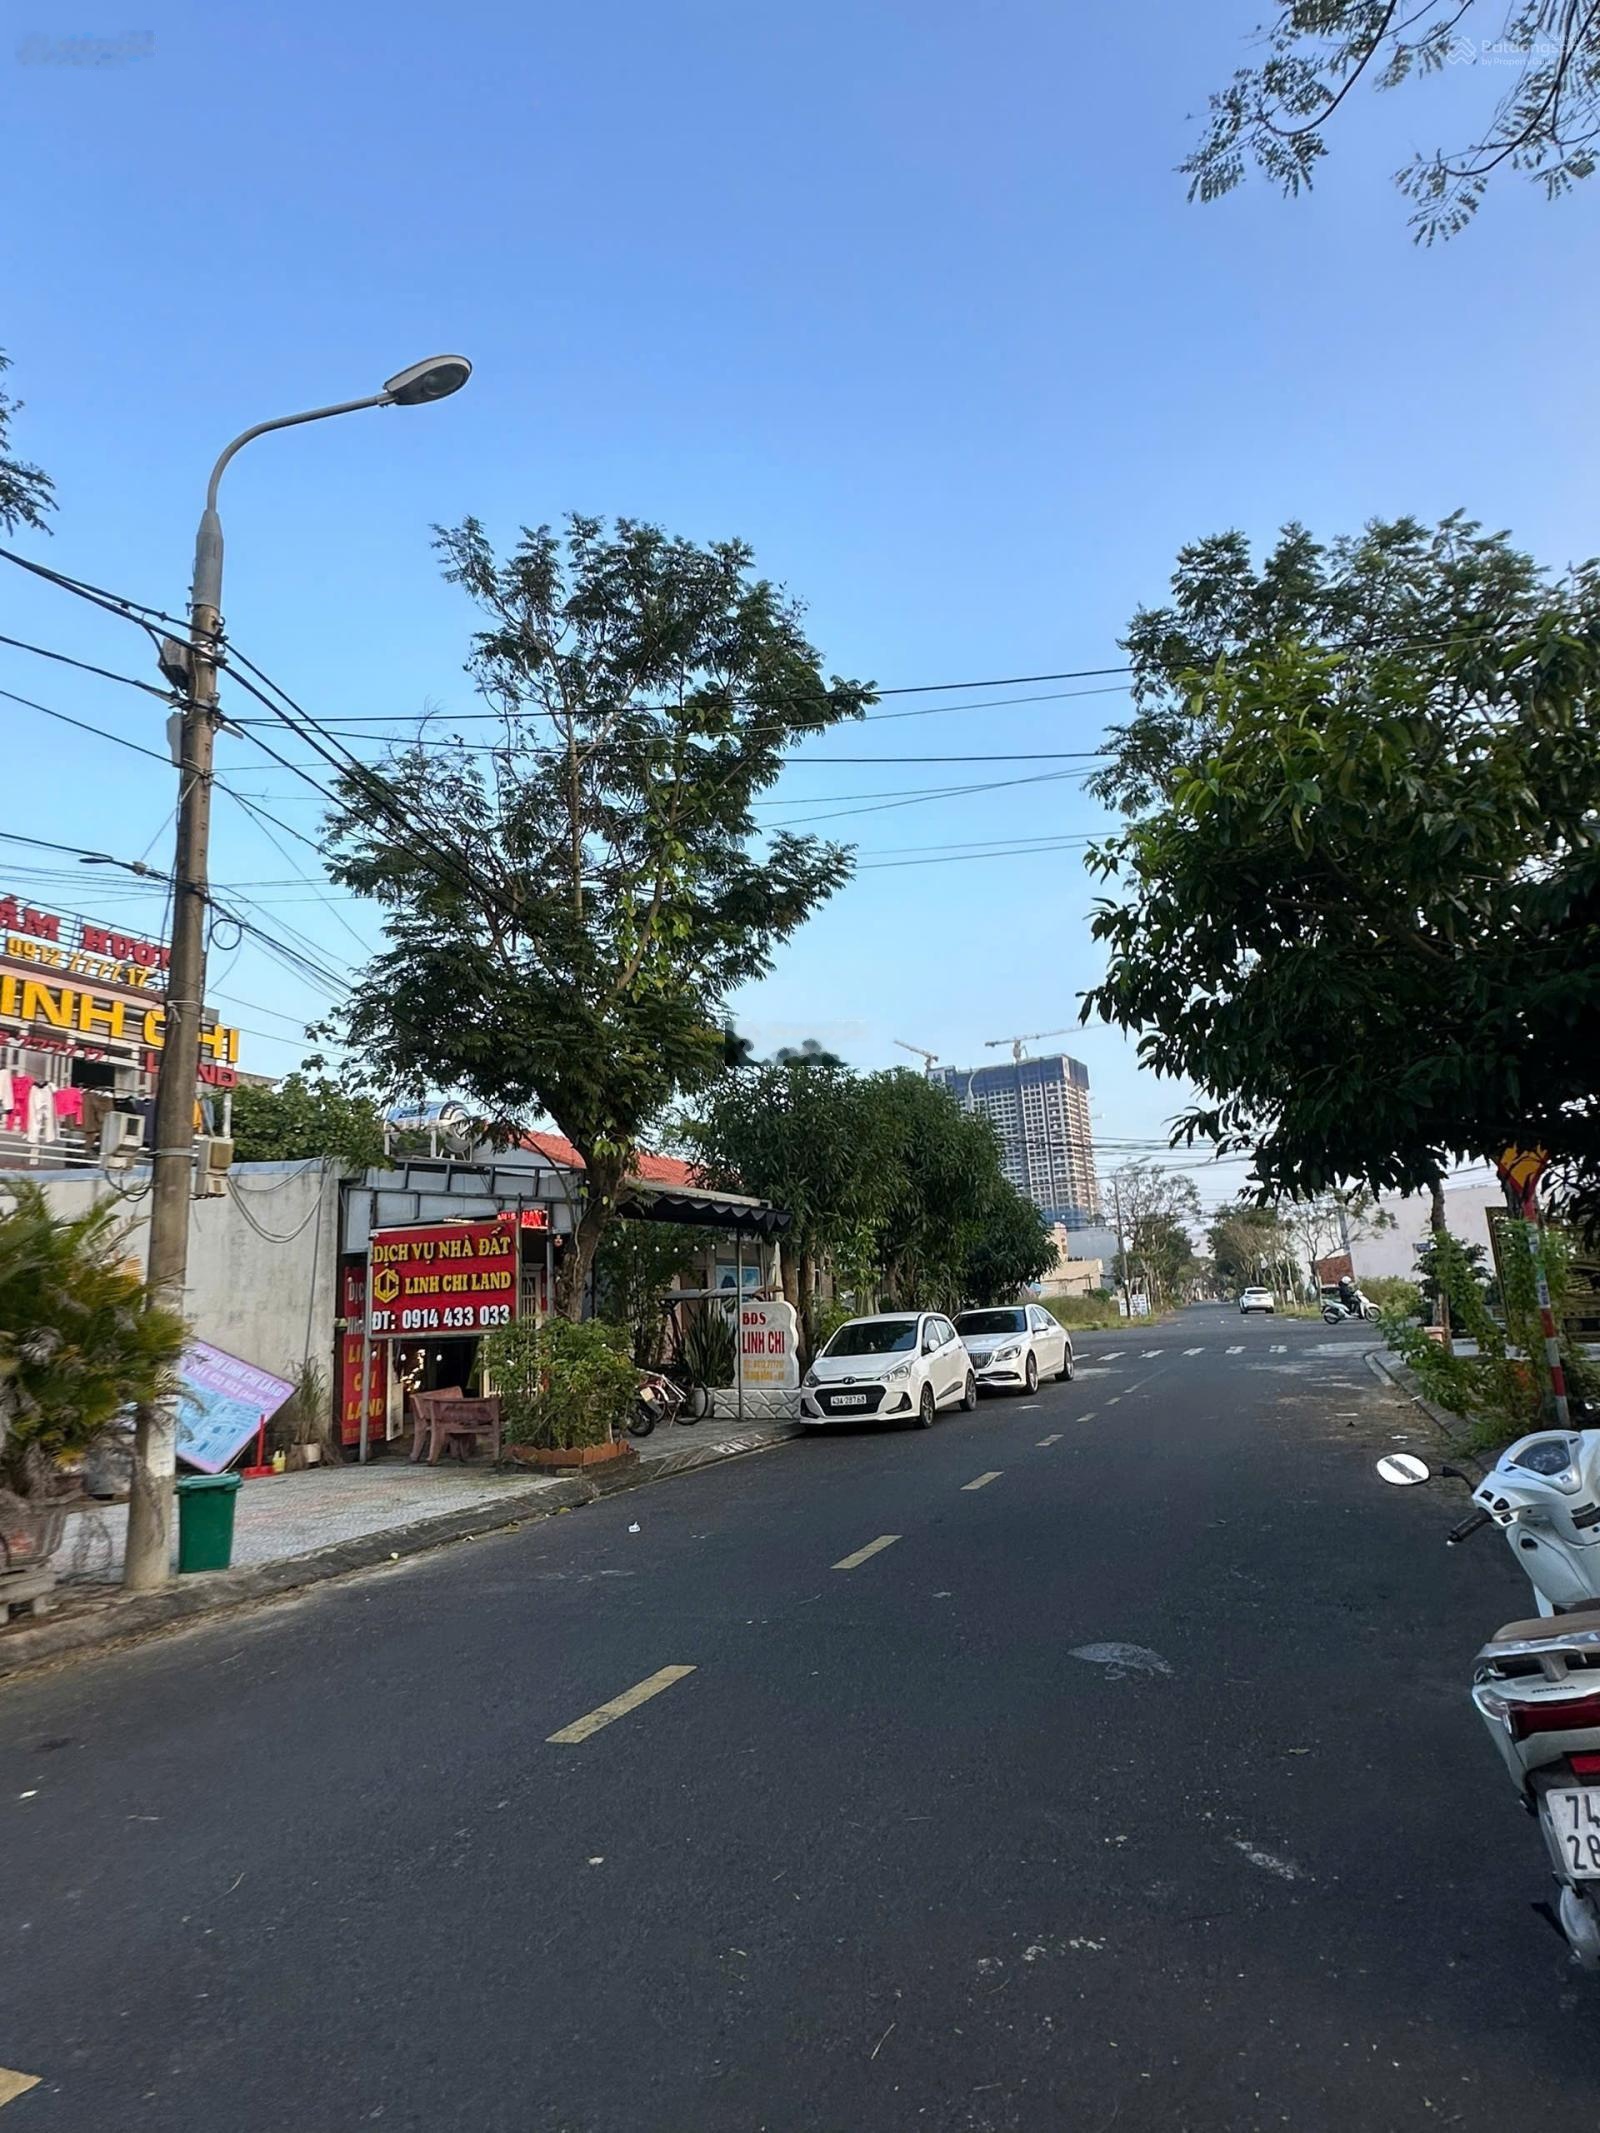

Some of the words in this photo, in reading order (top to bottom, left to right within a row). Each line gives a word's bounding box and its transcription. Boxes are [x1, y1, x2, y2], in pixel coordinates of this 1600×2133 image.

[8, 936, 61, 966] 0912
[68, 952, 122, 981] 7777
[127, 967, 149, 988] 17
[146, 1051, 237, 1088] LND
[373, 1243, 409, 1267] DỊCH
[411, 1241, 435, 1264] VỤ
[438, 1234, 474, 1259] NHÀ
[478, 1227, 512, 1256] ĐẤT
[404, 1275, 440, 1294] LINH
[442, 1273, 468, 1292] CHI
[471, 1271, 512, 1291] LAND
[372, 1309, 396, 1331] ĐT:
[402, 1308, 439, 1330] 0914
[443, 1305, 474, 1327] 433
[479, 1304, 510, 1327] 033
[742, 1330, 765, 1354] LINH
[768, 1330, 785, 1354] CHI
